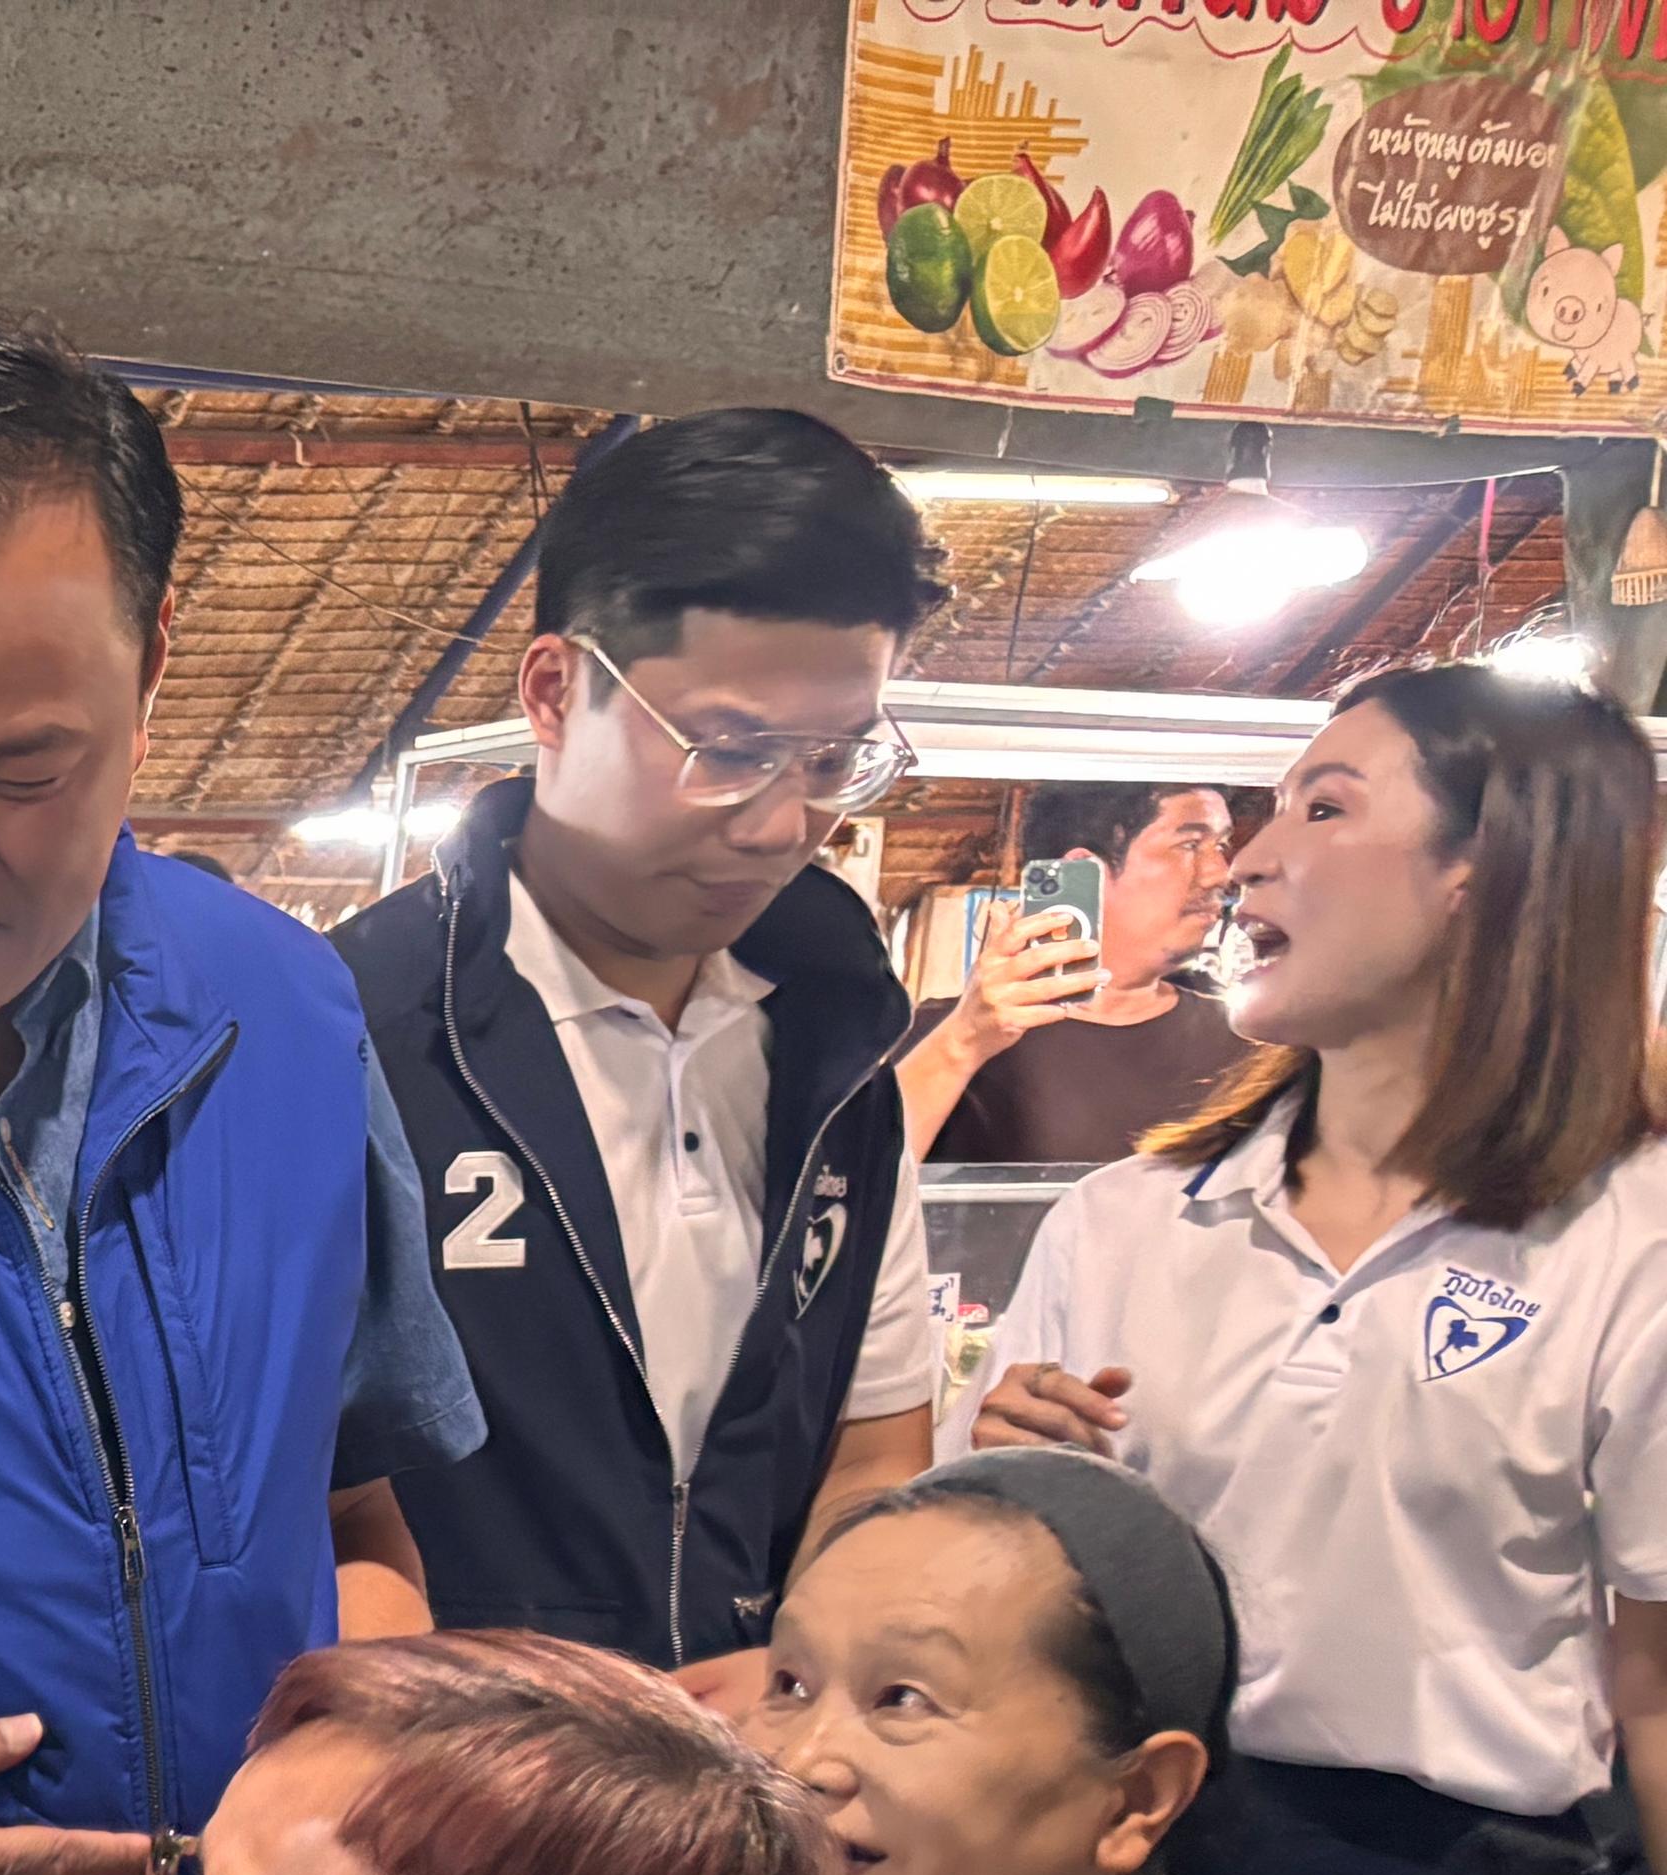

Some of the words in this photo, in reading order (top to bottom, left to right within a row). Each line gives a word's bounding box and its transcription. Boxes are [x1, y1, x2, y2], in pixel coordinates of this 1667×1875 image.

[442, 1151, 526, 1270] 2
[1443, 1267, 1542, 1317] ภูมิใจไทย
